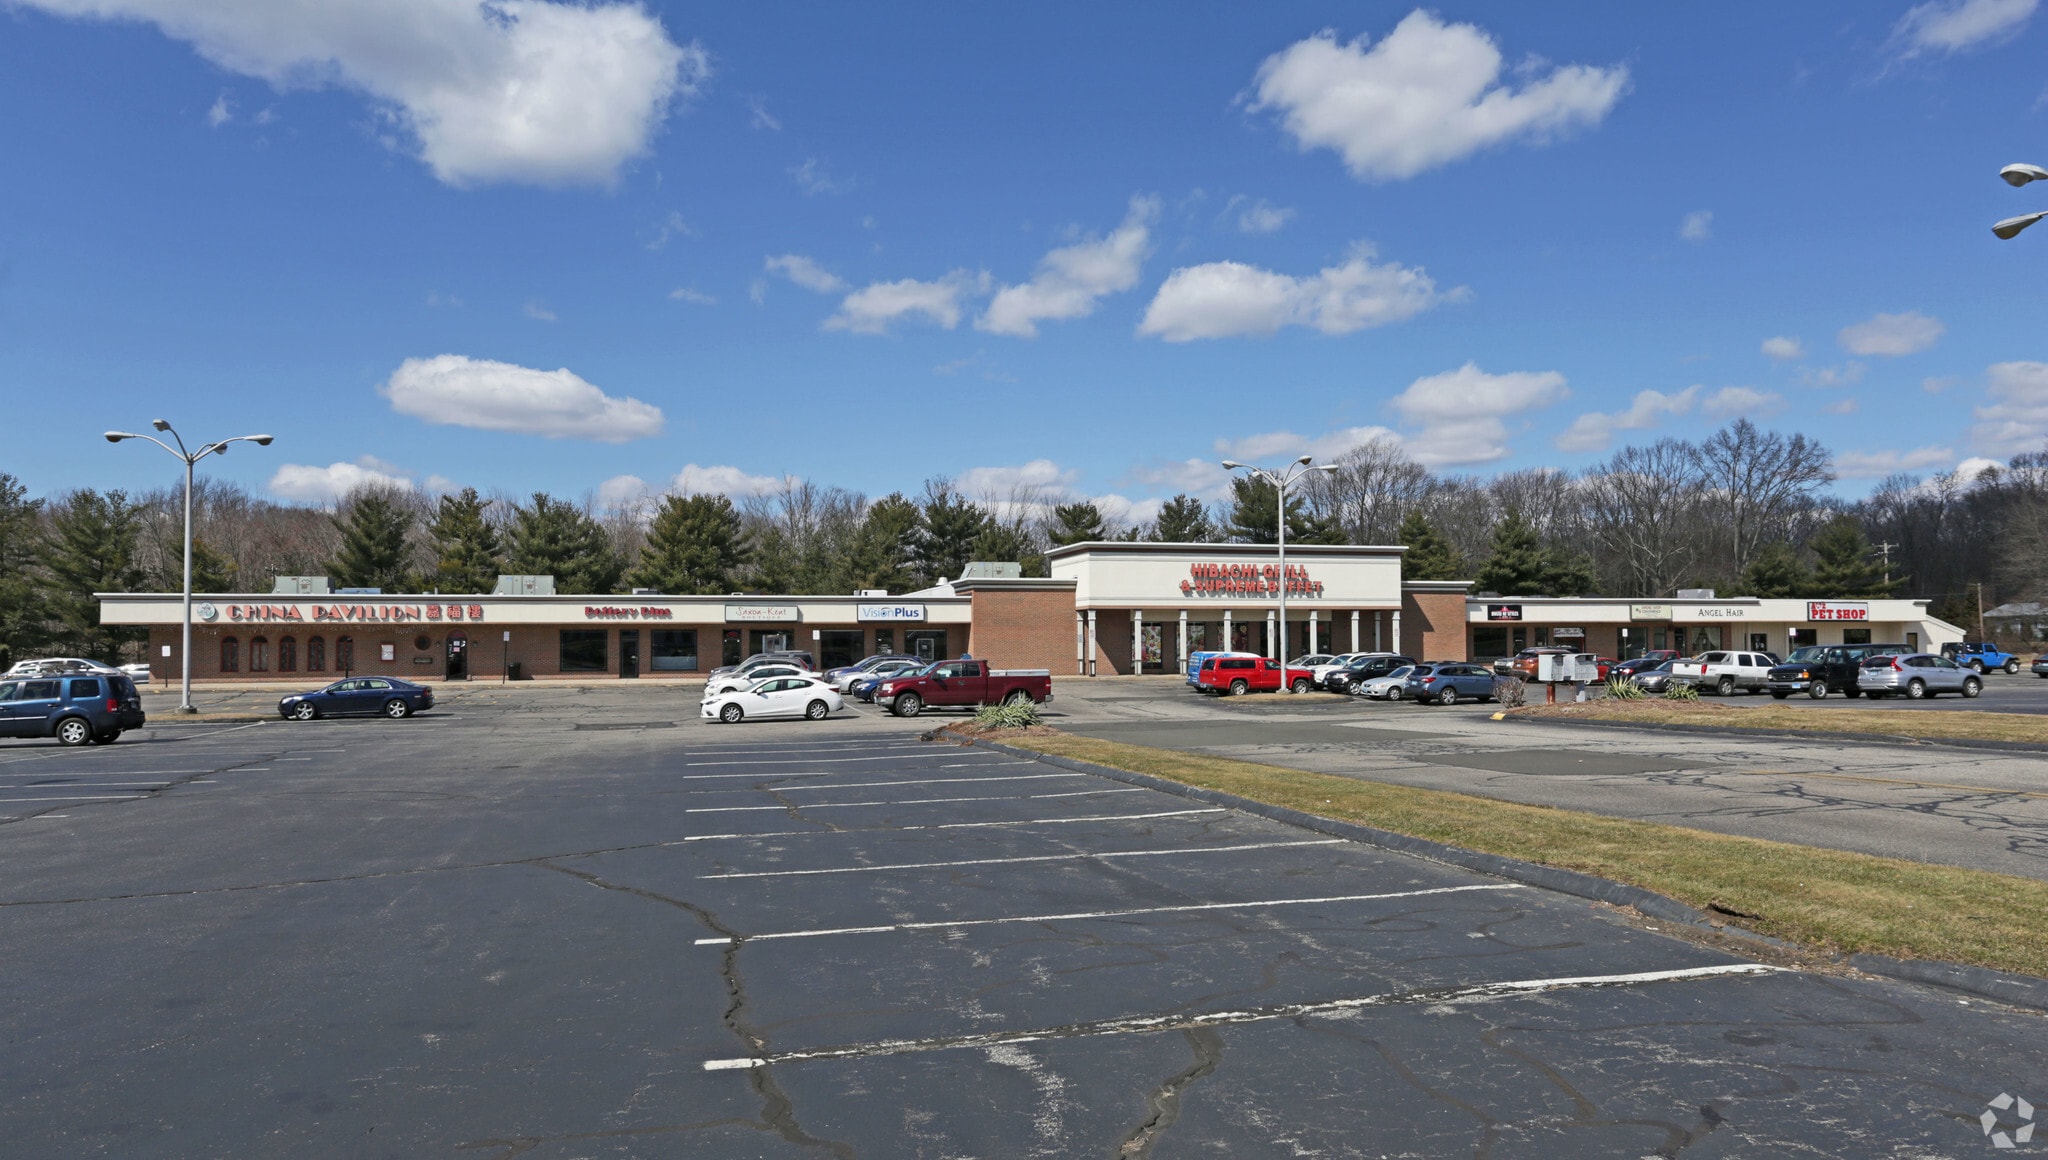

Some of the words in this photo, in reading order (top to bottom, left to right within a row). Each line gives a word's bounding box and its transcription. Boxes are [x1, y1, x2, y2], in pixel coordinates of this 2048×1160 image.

[1191, 563, 1258, 578] HIBACHI
[1181, 580, 1191, 592] &
[1195, 580, 1264, 592] SUPREME
[226, 604, 302, 619] CHINA
[312, 604, 420, 619] PAVILION
[585, 606, 637, 616] Pottery
[641, 606, 671, 616] Plus
[1698, 608, 1723, 617] ANGEL
[1726, 608, 1744, 617] HAIR
[1811, 609, 1834, 619] PET
[1836, 609, 1866, 619] SHOP
